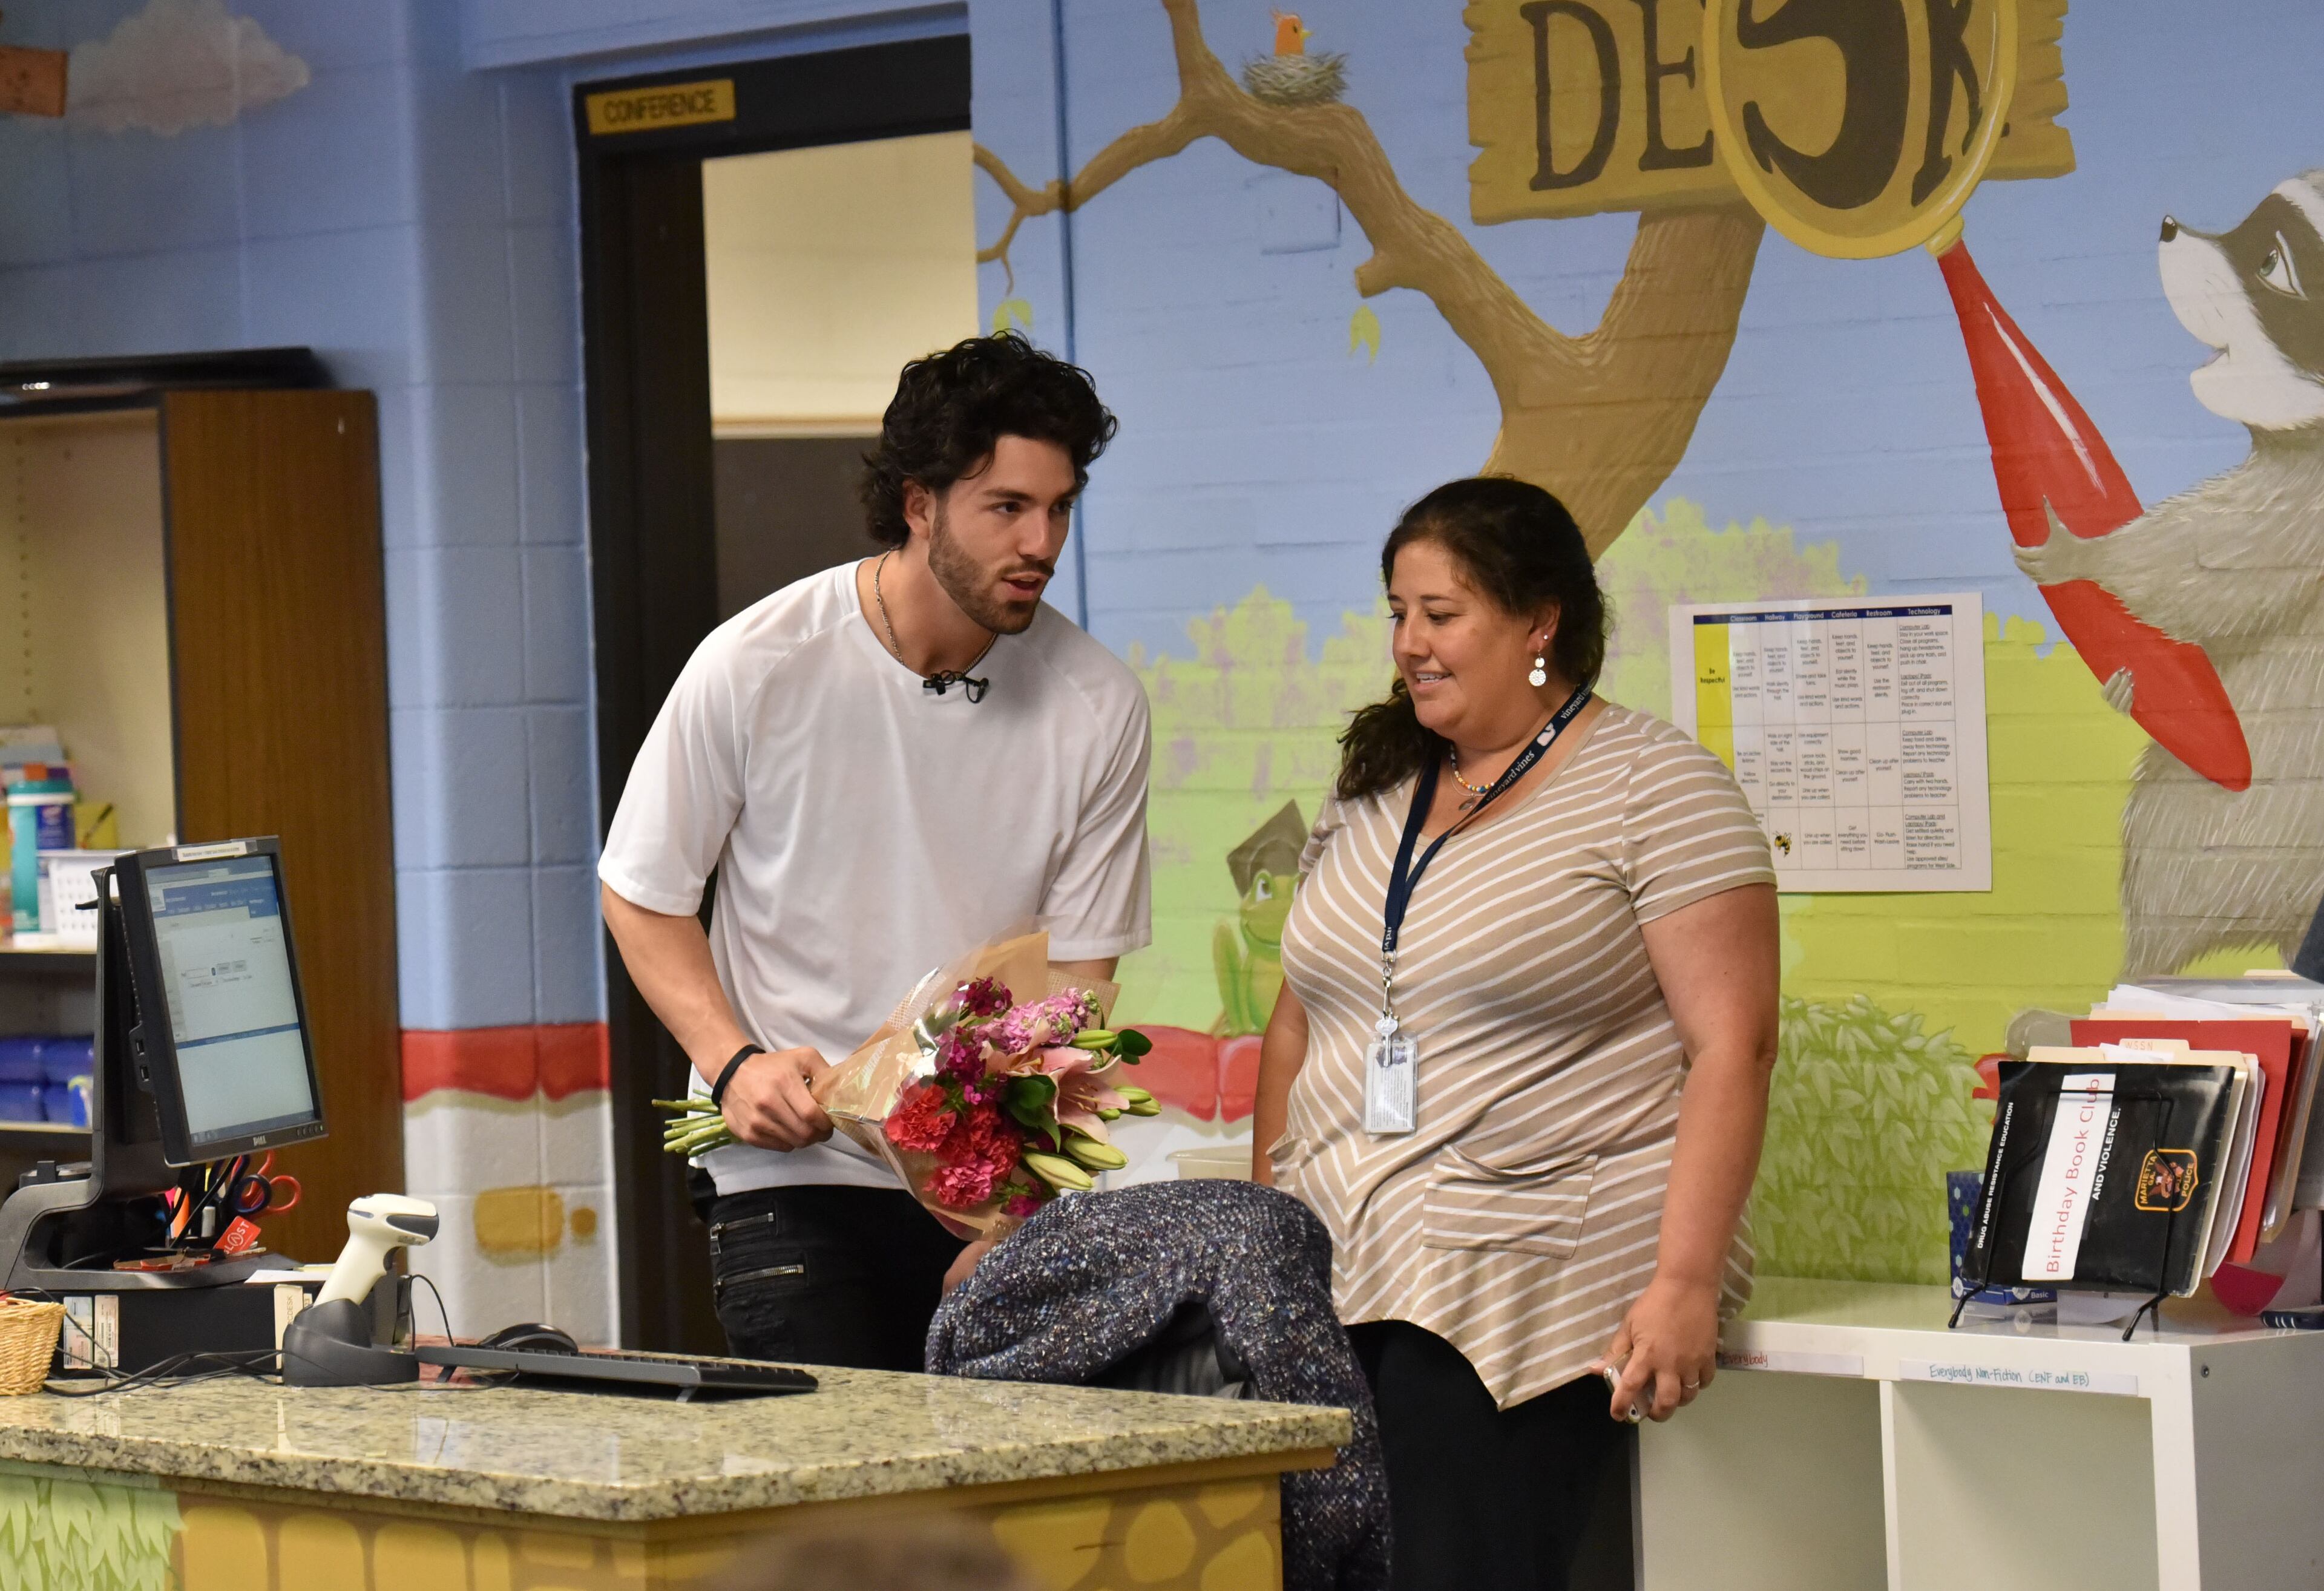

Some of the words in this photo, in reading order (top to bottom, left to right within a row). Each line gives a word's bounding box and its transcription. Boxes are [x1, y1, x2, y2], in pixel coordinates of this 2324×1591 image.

[1793, 612, 1823, 620] Playground
[1908, 607, 1940, 616] Technology
[1561, 694, 1584, 720] vineyard
[1486, 769, 1517, 801] vineyard
[1515, 750, 1535, 772] vines
[2092, 1170, 2104, 1200] AND
[2098, 1108, 2121, 1169] VIOLENCE.
[1978, 1226, 1987, 1248] DRUG
[1984, 1196, 1994, 1225] ABUSE
[1989, 1149, 2003, 1196] RESISTANCE
[2000, 1102, 2014, 1147] EDUCATION
[2046, 1187, 2077, 1272] Birthday
[2066, 1130, 2088, 1179] Book
[2079, 1078, 2099, 1122] Club
[2139, 1156, 2158, 1204] MARIETTA
[2181, 1163, 2194, 1197] POLICE
[2031, 1291, 2049, 1299] Basic
[1723, 1351, 1768, 1368] Everybody
[1929, 1364, 1972, 1382] Everybody
[1976, 1367, 2022, 1382] Non-Fiction
[2029, 1370, 2052, 1383] (ENF
[2055, 1373, 2069, 1383] and
[2073, 1372, 2089, 1386] EB)
